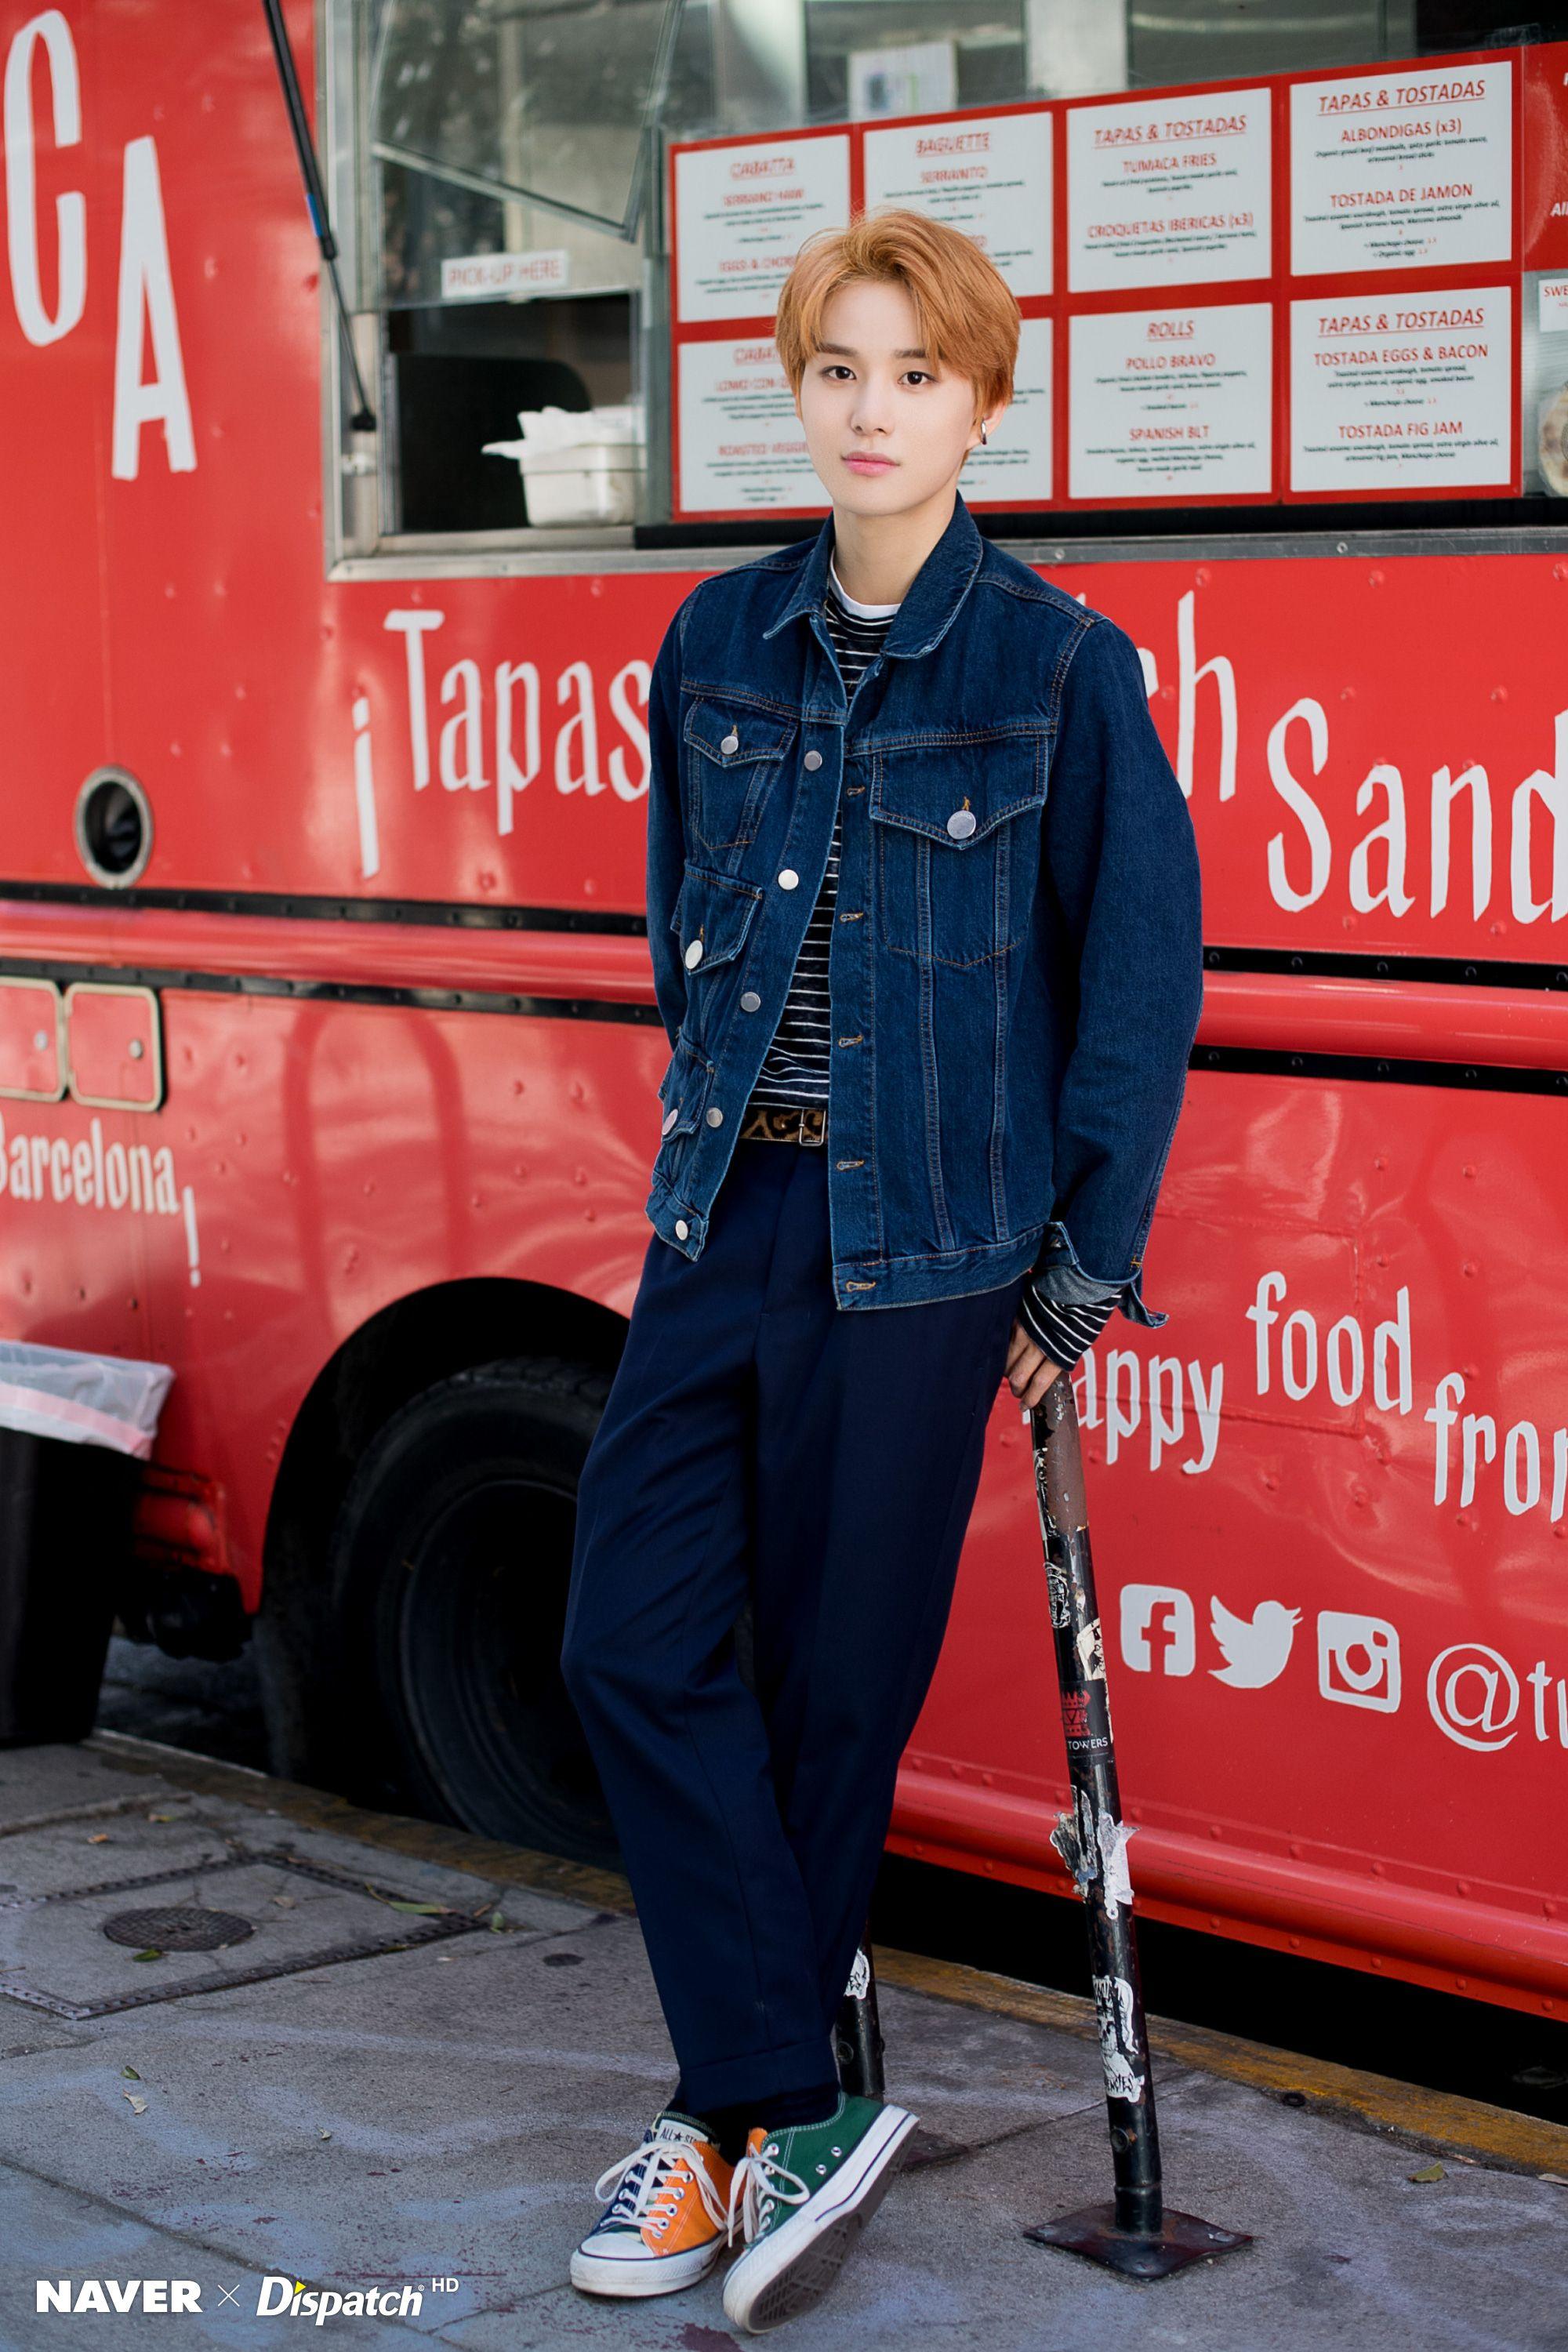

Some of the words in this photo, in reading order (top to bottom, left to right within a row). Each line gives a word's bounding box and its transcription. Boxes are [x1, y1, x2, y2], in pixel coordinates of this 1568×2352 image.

[1319, 92, 1370, 112] TAPAS
[1377, 89, 1388, 106] &
[1396, 80, 1486, 103] TOSTADAS
[1094, 125, 1142, 144] TAPAS
[1147, 124, 1159, 140] &
[1165, 115, 1247, 139] TOSTADAS
[1341, 122, 1431, 142] ALBONDIGAS
[1436, 118, 1462, 136] (x3)
[1123, 156, 1179, 173] TUMACA
[1182, 153, 1217, 169] FRIES
[1331, 191, 1394, 208] TOSTADA
[1399, 188, 1414, 202] DE
[1421, 183, 1473, 201] JAMON
[1088, 220, 1164, 238] CROQUETAS
[1170, 214, 1225, 231] IBERICAS
[1148, 320, 1194, 339] ROLLS
[1319, 315, 1370, 334] TAPAS
[1377, 314, 1388, 330] &
[1396, 308, 1484, 329] TOSTADAS
[1125, 357, 1167, 371] POLLO
[1171, 354, 1216, 368] BRAVO
[1314, 350, 1378, 366] TOSTADA
[1382, 347, 1418, 363] EGGS
[1423, 347, 1434, 361] &
[1439, 344, 1488, 358] BACON
[1130, 426, 1184, 441] SPANISH
[1189, 425, 1209, 439] BLT
[1338, 423, 1403, 439] TOSTADA
[1407, 422, 1428, 436] FIG
[1433, 420, 1463, 435] JAM
[1246, 1271, 1412, 1414] food
[1068, 1737, 1109, 1750] TOWERS
[660, 2126, 673, 2141] ALL
